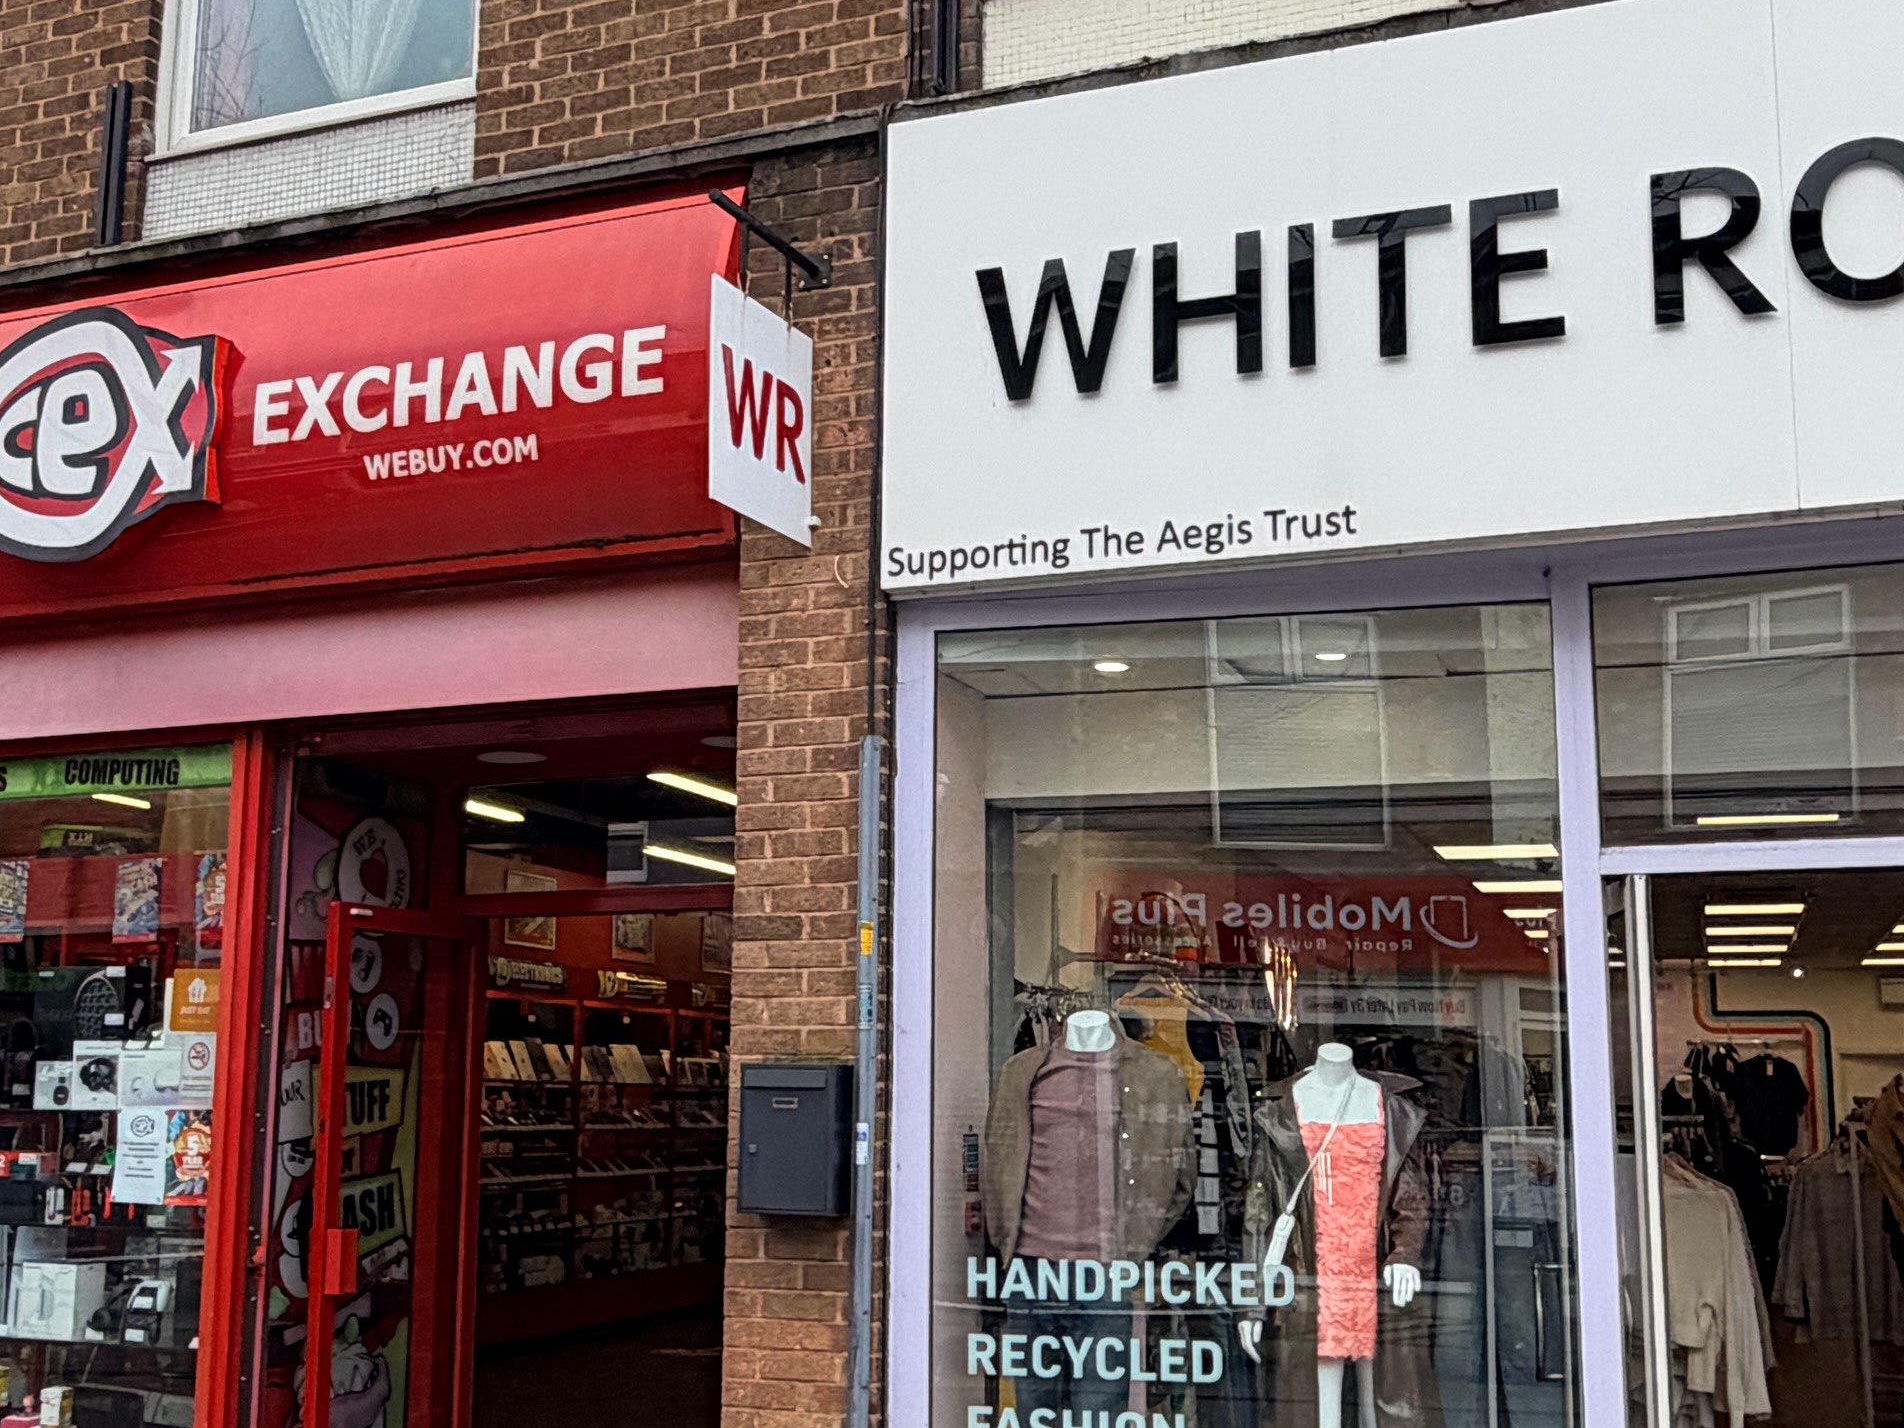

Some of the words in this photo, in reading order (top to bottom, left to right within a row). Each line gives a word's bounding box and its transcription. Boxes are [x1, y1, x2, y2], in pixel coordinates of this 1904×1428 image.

[975, 188, 1566, 403] WHITE
[252, 324, 667, 446] EXCHANGE
[721, 343, 806, 485] WR
[362, 433, 539, 481] WEBUY.COM
[887, 534, 1071, 581] Supporting
[1080, 525, 1145, 560] The
[1156, 514, 1253, 554] Aegis
[1263, 505, 1358, 542] Trust
[63, 757, 181, 786] COMPUTING
[343, 1078, 390, 1125] UFF
[343, 1182, 395, 1237] ASH
[966, 1256, 1296, 1308] HANDPICKED
[967, 1333, 1224, 1384] RECYCLED
